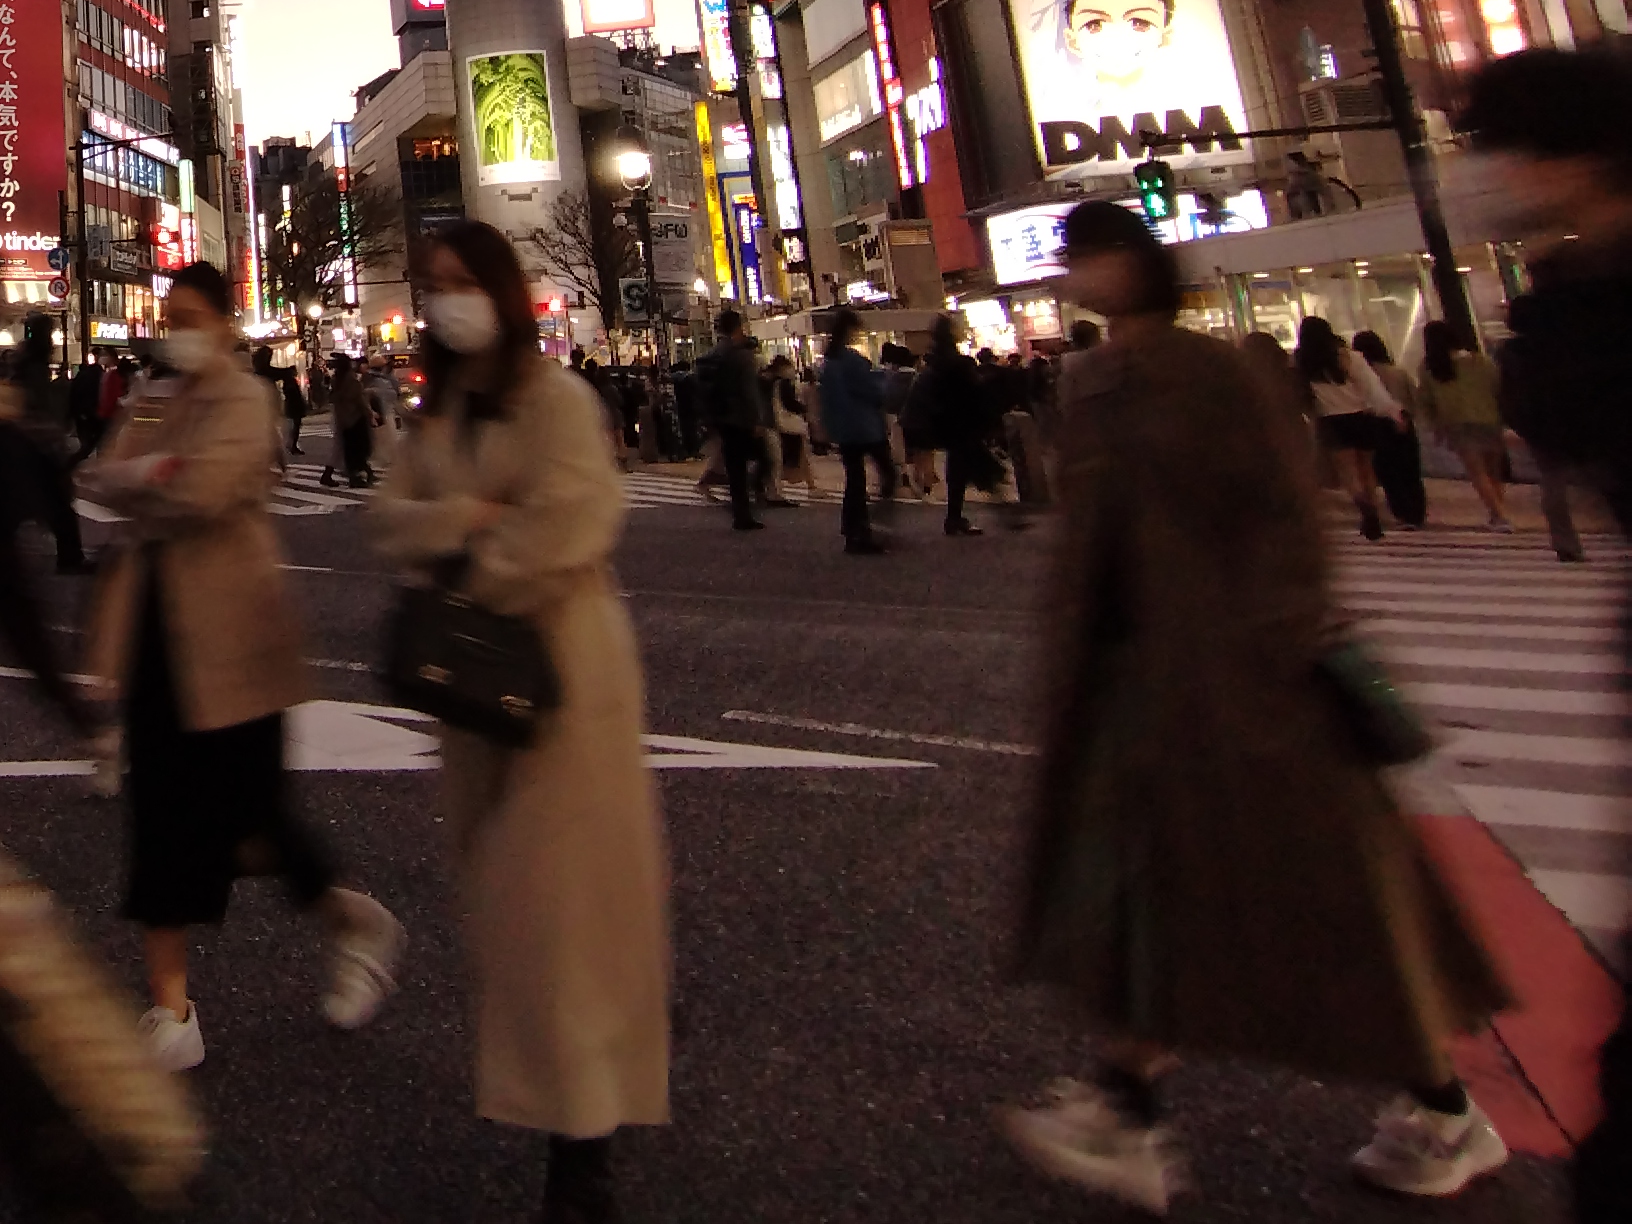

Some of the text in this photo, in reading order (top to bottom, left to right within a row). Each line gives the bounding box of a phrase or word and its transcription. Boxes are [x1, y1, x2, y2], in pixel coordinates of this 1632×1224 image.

[1038, 105, 1245, 167] DMM
[4, 230, 61, 251] tinder
[152, 274, 175, 299] LUS
